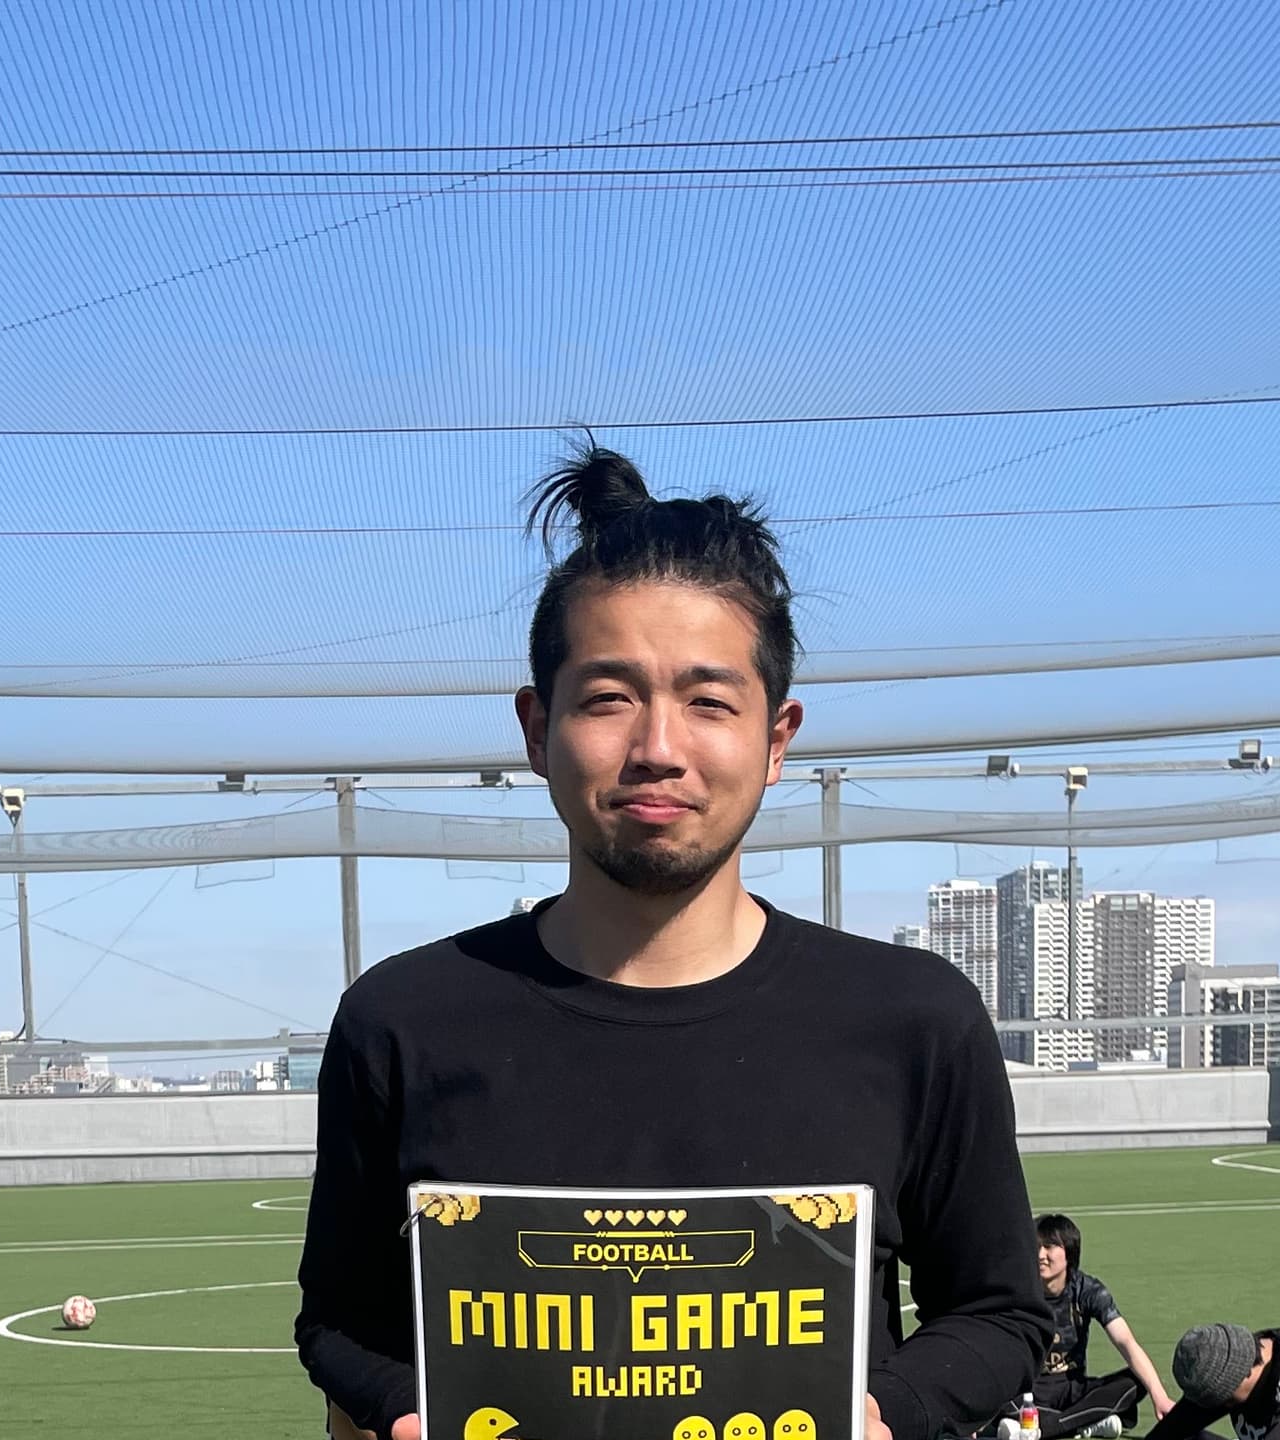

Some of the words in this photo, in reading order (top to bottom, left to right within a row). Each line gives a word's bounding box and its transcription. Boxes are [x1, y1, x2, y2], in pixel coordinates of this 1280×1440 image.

[573, 1243, 694, 1262] FOOTBALL
[449, 1289, 594, 1352] MINI
[631, 1288, 825, 1352] GAME
[572, 1364, 702, 1397] AWARD
